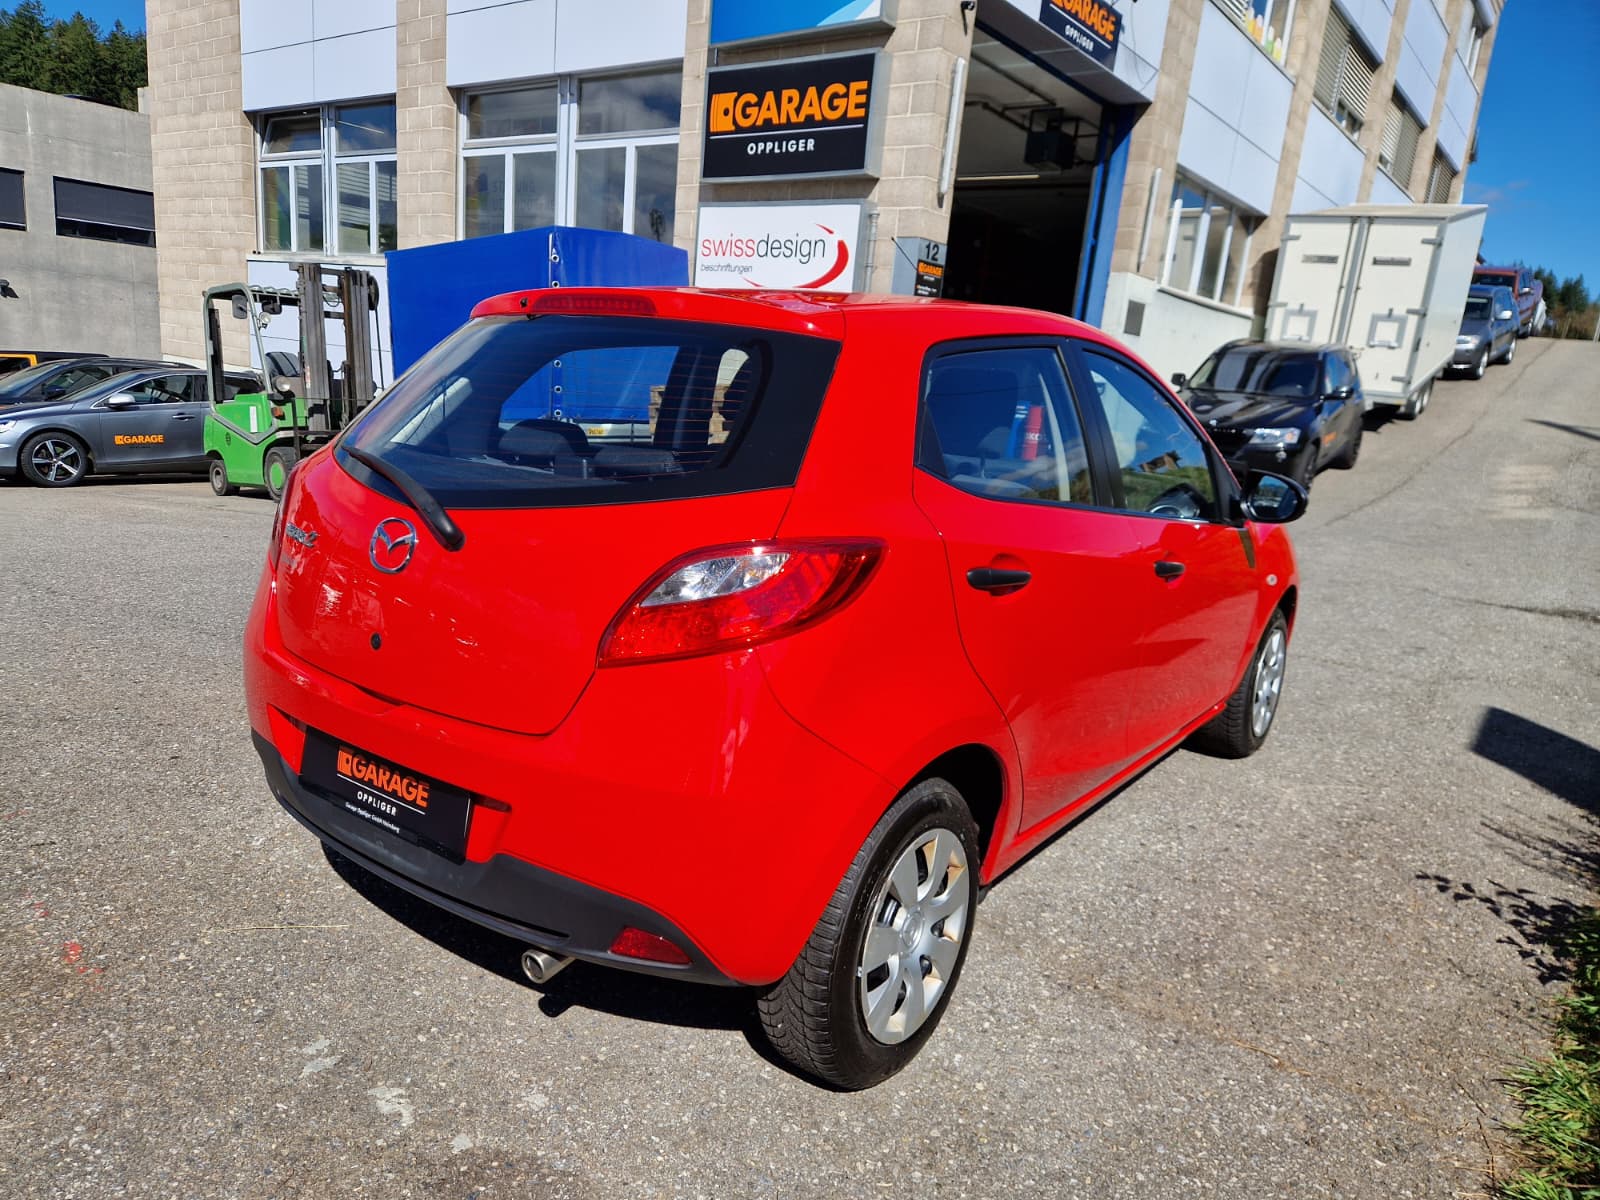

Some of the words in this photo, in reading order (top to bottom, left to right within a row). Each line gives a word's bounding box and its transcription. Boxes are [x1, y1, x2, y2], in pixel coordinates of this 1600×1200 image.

[734, 80, 868, 128] GARAGE
[747, 138, 815, 155] OPPLIGER
[701, 233, 826, 265] swissdesign
[926, 241, 940, 262] 12
[123, 434, 165, 444] GARAGE
[352, 754, 430, 808] GARAGE
[357, 791, 397, 816] OPPLIGER
